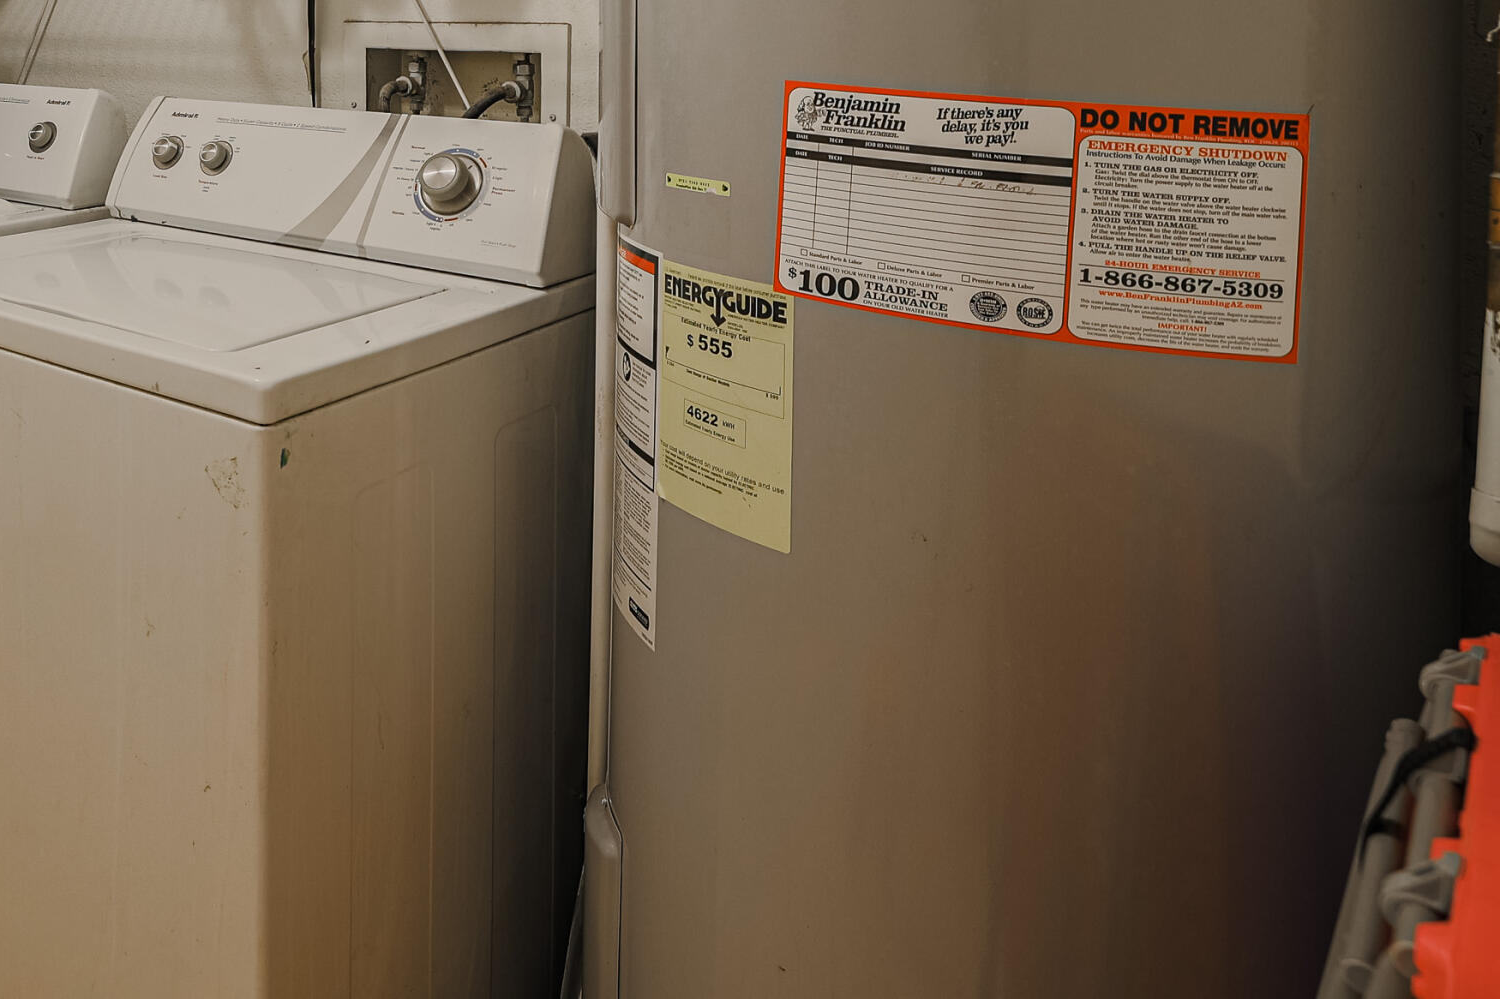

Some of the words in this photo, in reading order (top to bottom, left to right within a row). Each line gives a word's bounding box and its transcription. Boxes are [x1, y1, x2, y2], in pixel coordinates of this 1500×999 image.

[813, 91, 900, 114] Benjamin
[823, 109, 906, 132] Franklin
[937, 108, 950, 120] If
[951, 107, 994, 120] there's
[997, 108, 1023, 121] any
[1081, 108, 1120, 130] DO
[1129, 111, 1185, 134] NOT
[1193, 115, 1300, 139] REMOVE
[834, 126, 865, 135] PUNCTUAL
[942, 121, 977, 135] delay,
[981, 119, 1000, 132] it's
[1003, 120, 1029, 133] you
[965, 135, 984, 144] we
[1087, 140, 1194, 157] EMERGENCY
[1199, 147, 1288, 162] SHUTDOWN
[1087, 150, 1132, 159] Instructions
[1146, 154, 1168, 162] Avoid
[1170, 155, 1202, 166] Damage
[1203, 158, 1226, 166] When
[1228, 159, 1256, 169] Leakage
[1259, 161, 1286, 169] Occurs:
[931, 166, 955, 174] SERVICE
[956, 168, 984, 176] RECORD
[1180, 168, 1238, 178] ELECTRICITY
[1093, 188, 1118, 196] TURN
[1142, 192, 1174, 200] WATER
[1176, 194, 1210, 203] SUPPLY
[1091, 208, 1120, 217] DRAIN
[1145, 213, 1176, 221] WATER
[1179, 215, 1214, 224] HEATER
[1092, 216, 1120, 224] AVOID
[1123, 218, 1154, 227] WATER
[1089, 242, 1112, 250] PULL
[1135, 245, 1173, 255] HANDLE
[1205, 251, 1224, 259] THE
[1226, 253, 1257, 261] RELIEF
[1105, 260, 1148, 270] 24-HOUR
[1152, 264, 1216, 275] EMERGENCY
[1219, 269, 1260, 279] SERVICE
[864, 280, 940, 301] TRADE-IN
[1079, 268, 1284, 299] 1-866-867-5309
[664, 273, 788, 324] ENERGYGUIDE
[863, 291, 948, 312] ALLOWANCE
[1099, 290, 1263, 310] www.BenFranklinPlumbingAZ.com
[905, 306, 925, 315] WATER
[926, 309, 948, 318] HEATER
[681, 317, 702, 329] Estimated
[703, 323, 718, 335] Yearly
[719, 328, 738, 340] Energy
[739, 333, 751, 342] Cost
[1158, 322, 1207, 332] IMPORTANT!
[698, 334, 732, 358] 555
[687, 405, 718, 427] 4622
[712, 463, 724, 474] your
[758, 482, 770, 490] and
[772, 486, 784, 495] use
